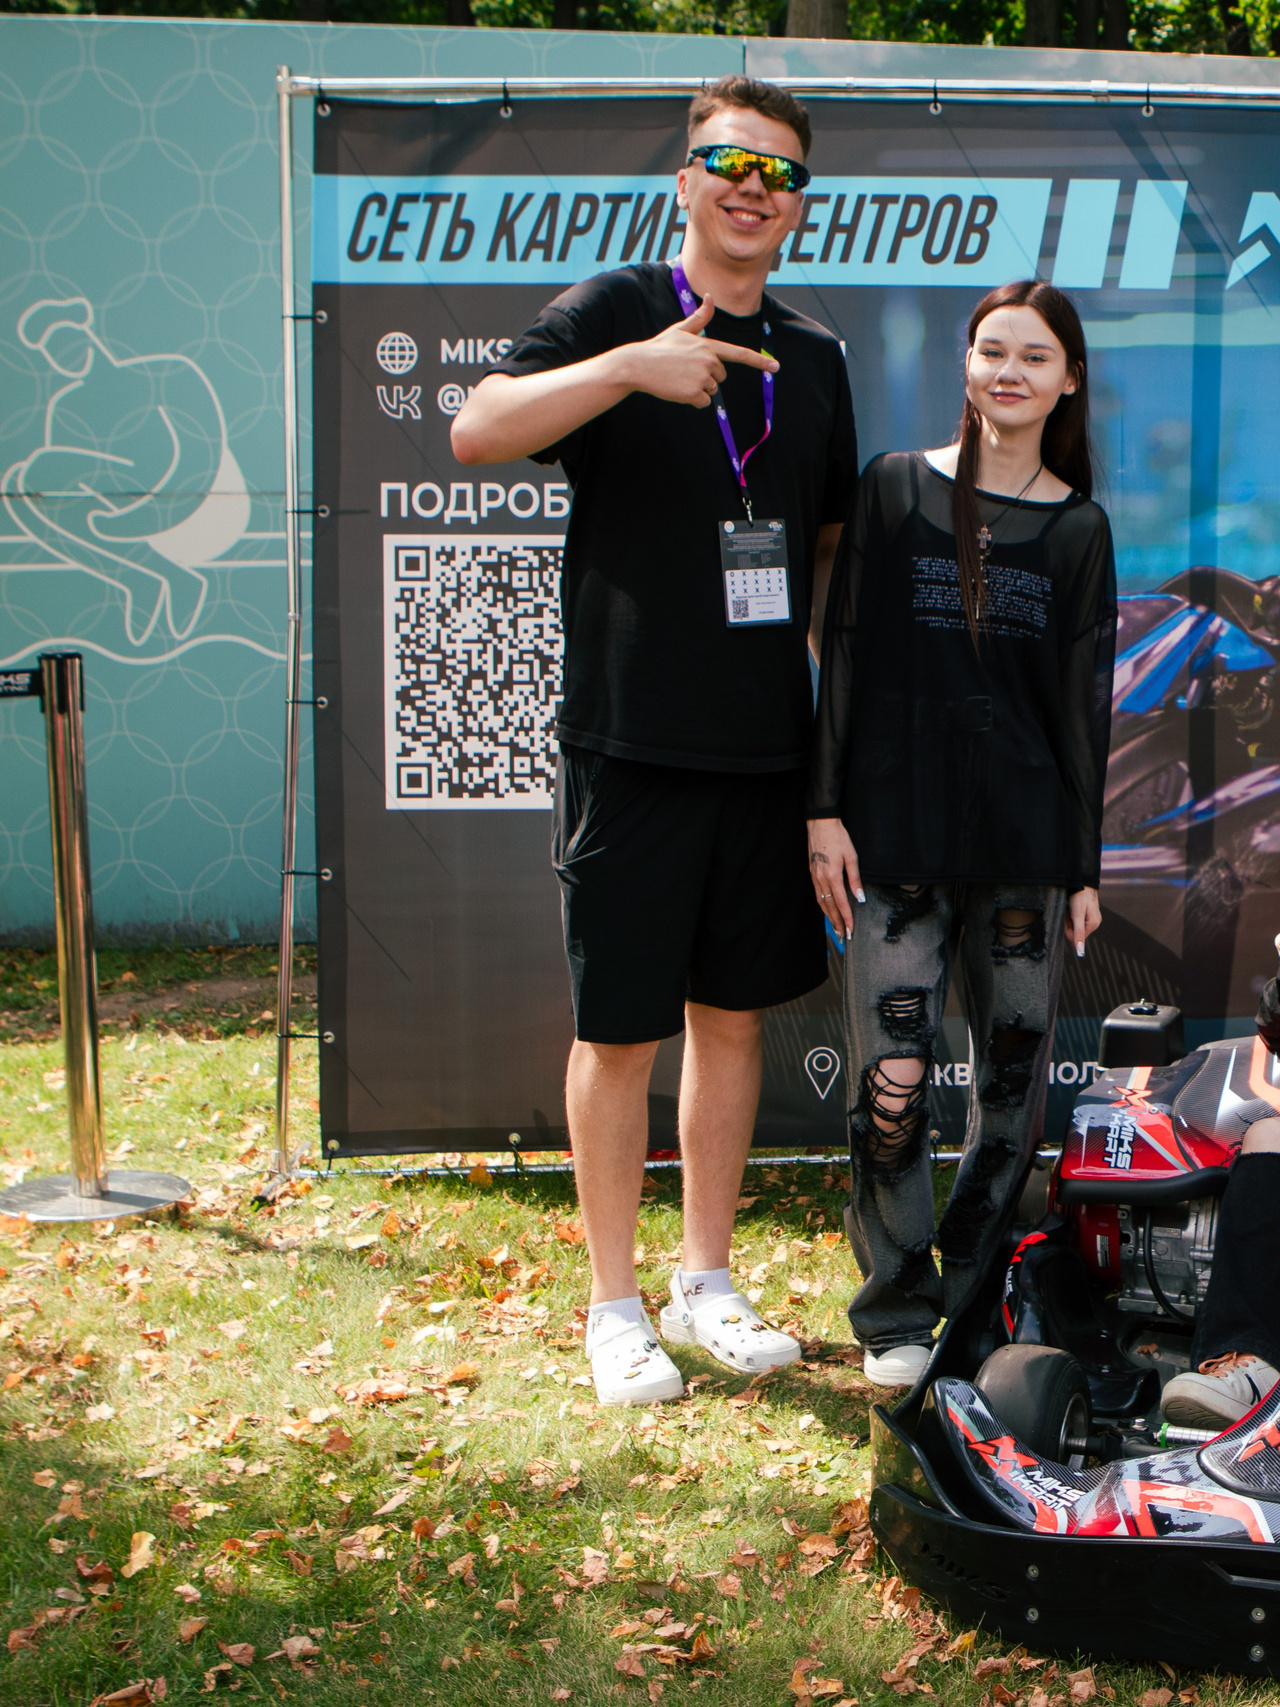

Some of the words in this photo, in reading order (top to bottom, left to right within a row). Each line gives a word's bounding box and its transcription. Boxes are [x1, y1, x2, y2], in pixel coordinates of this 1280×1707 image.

[346, 192, 476, 263] СЕТЬ
[380, 482, 571, 525] ПОДРОБ
[1103, 1113, 1122, 1168] KART
[1115, 1115, 1137, 1173] MIKS
[1011, 1473, 1073, 1511] KART
[1026, 1470, 1086, 1501] MIKS
